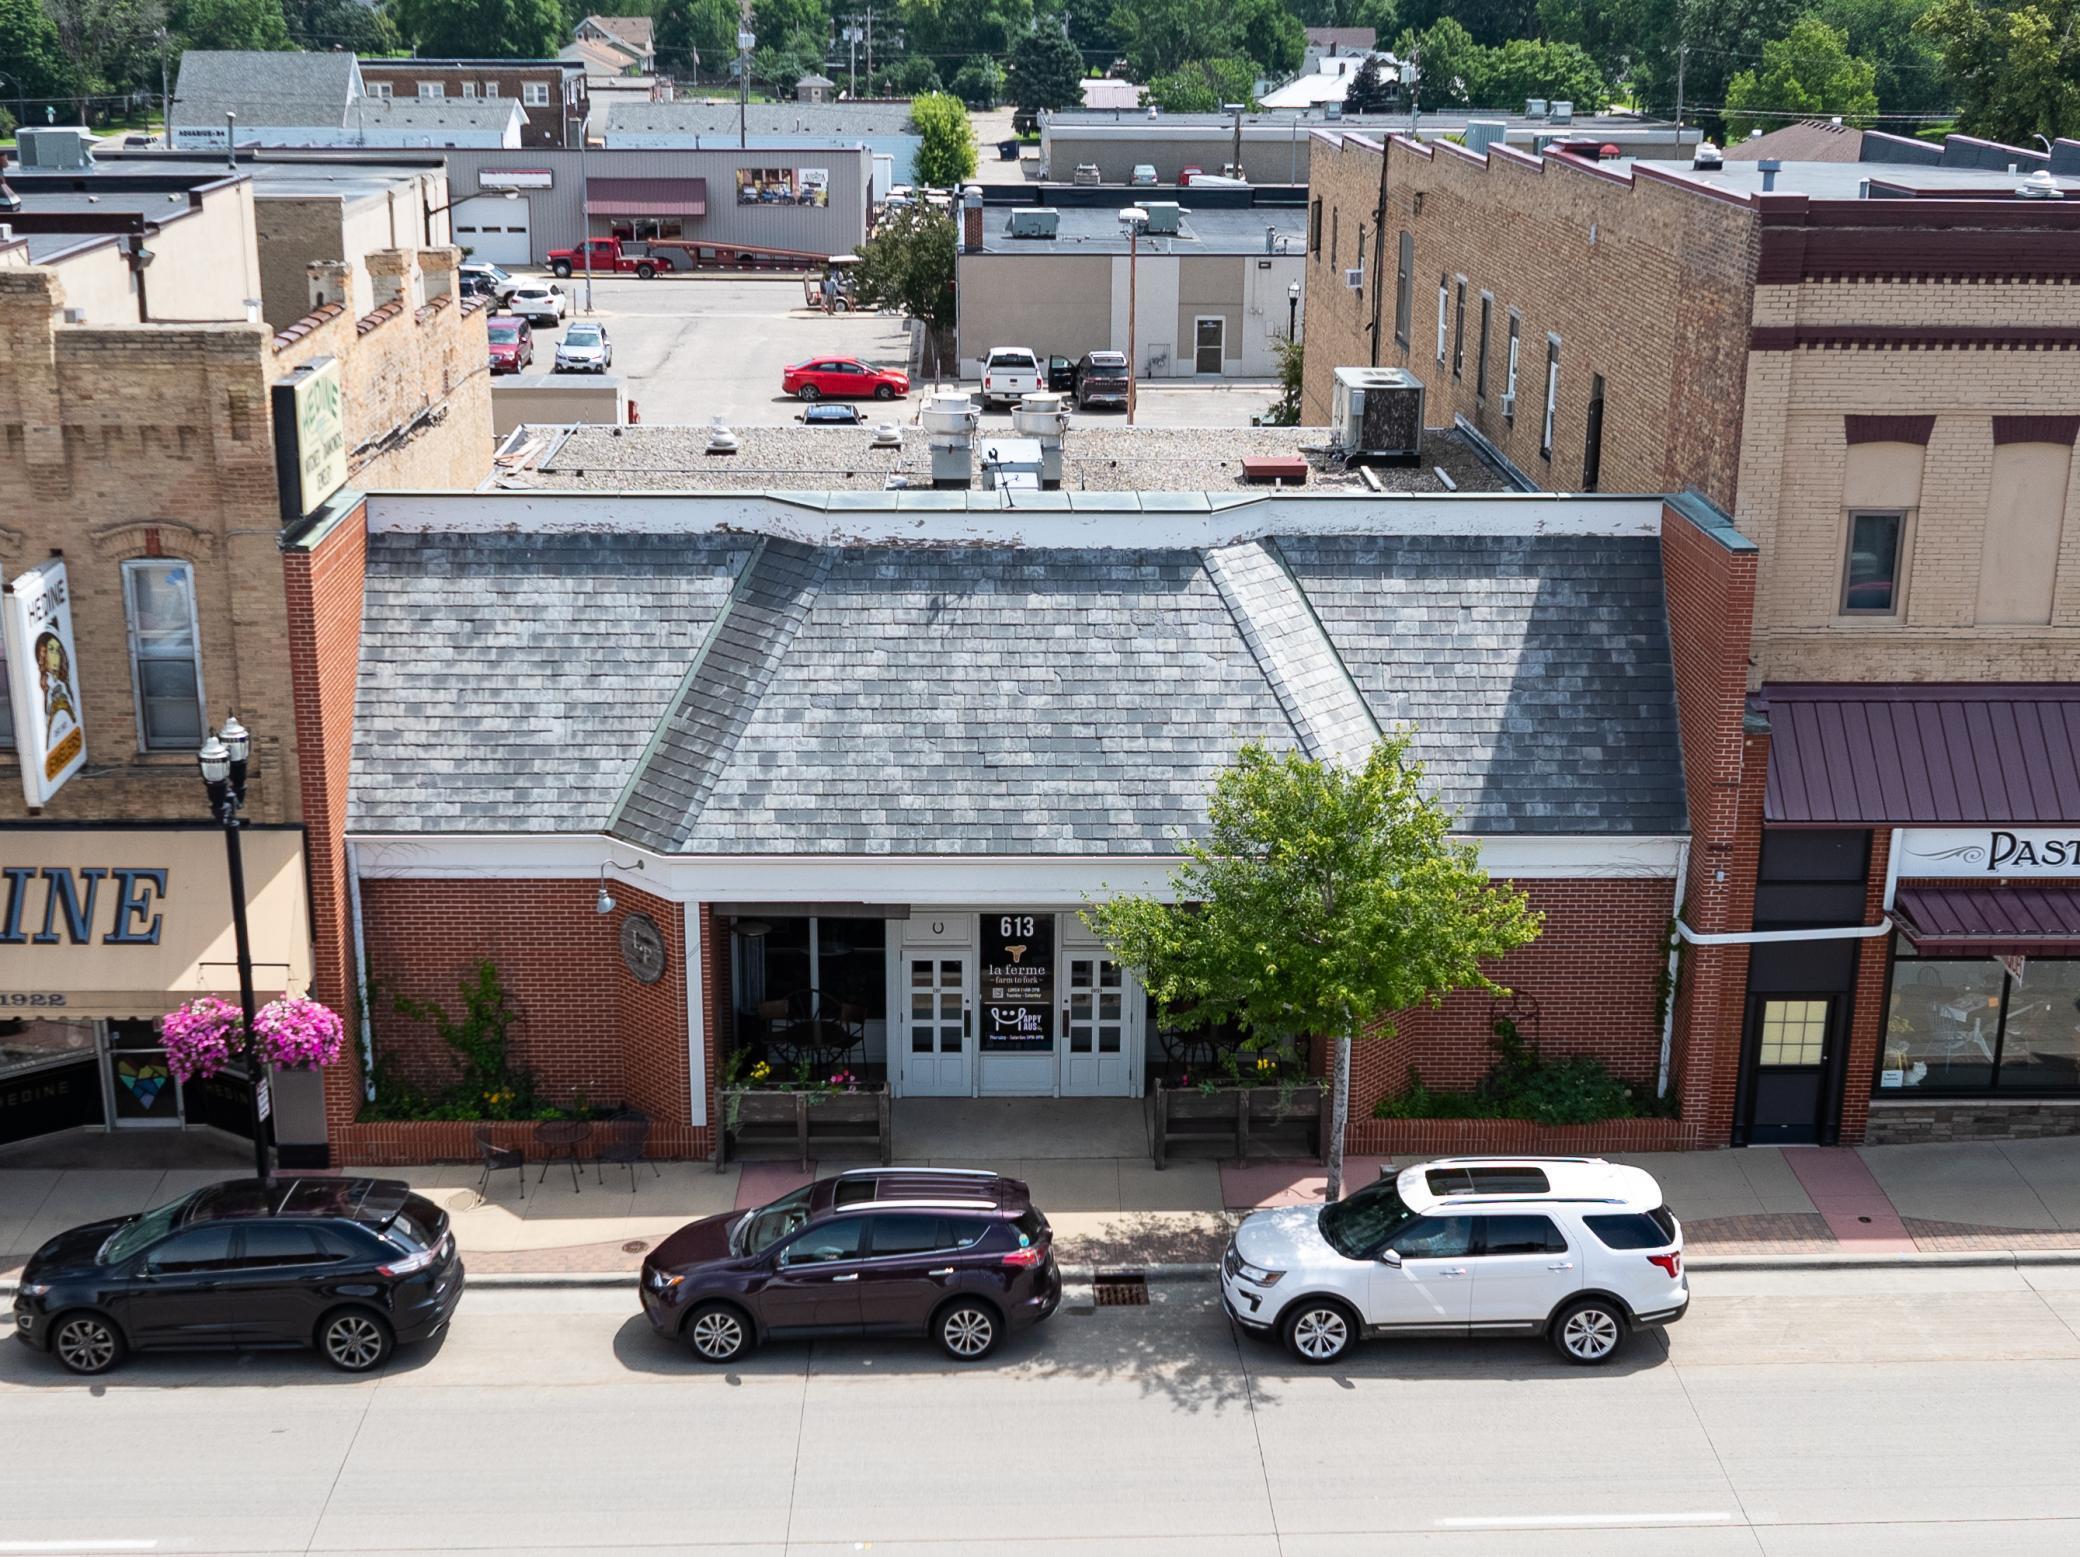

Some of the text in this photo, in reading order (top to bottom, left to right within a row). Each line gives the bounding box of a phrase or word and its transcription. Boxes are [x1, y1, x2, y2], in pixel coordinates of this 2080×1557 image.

[27, 579, 66, 625] HEDINE
[0, 867, 169, 946] INE
[1000, 916, 1034, 937] 613
[989, 964, 1046, 975] la ferme
[995, 976, 1013, 984] farm
[1014, 976, 1022, 984] to
[0, 993, 67, 1007] 1922
